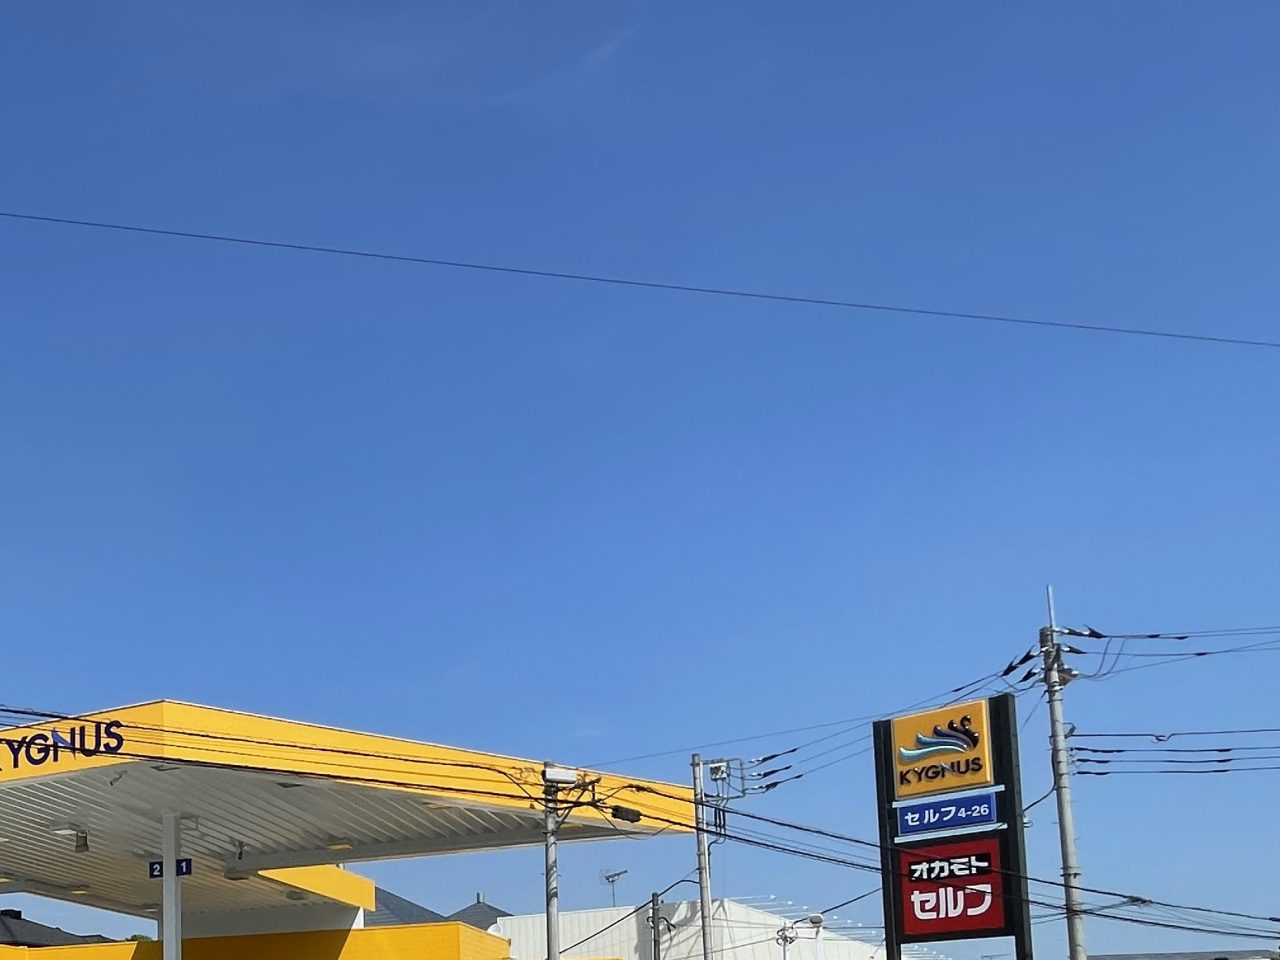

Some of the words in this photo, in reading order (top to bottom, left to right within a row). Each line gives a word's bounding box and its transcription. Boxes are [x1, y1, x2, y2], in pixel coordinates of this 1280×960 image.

[899, 756, 983, 786] KYGNUS
[153, 863, 161, 876] 2
[180, 861, 187, 873] 1
[910, 855, 989, 880] オカモト
[910, 883, 992, 920] セルフ
